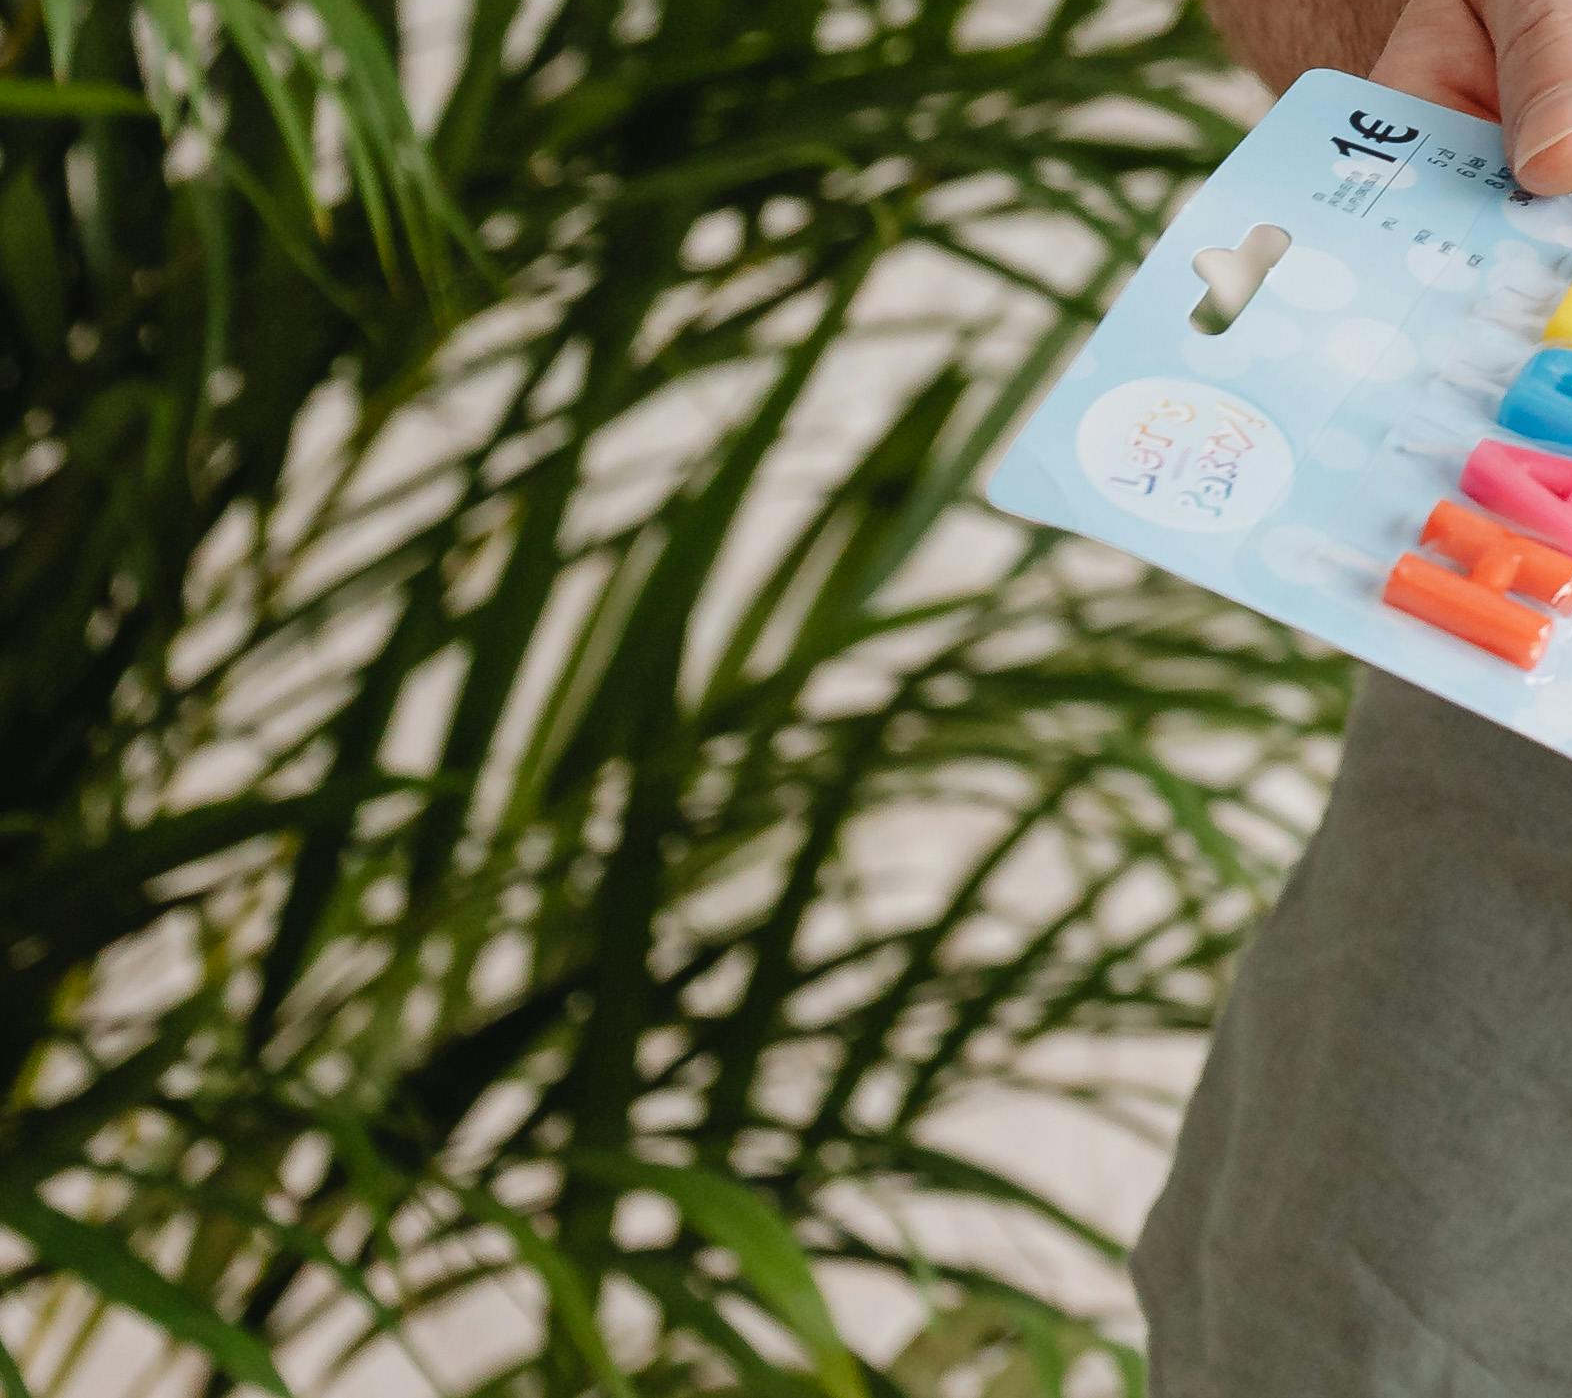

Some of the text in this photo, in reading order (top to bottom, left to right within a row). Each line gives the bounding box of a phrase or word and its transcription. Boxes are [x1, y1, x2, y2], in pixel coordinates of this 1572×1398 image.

[1330, 110, 1419, 163] 1€
[1427, 156, 1448, 168] 5
[1456, 167, 1476, 179] 6
[1485, 178, 1505, 190] 8
